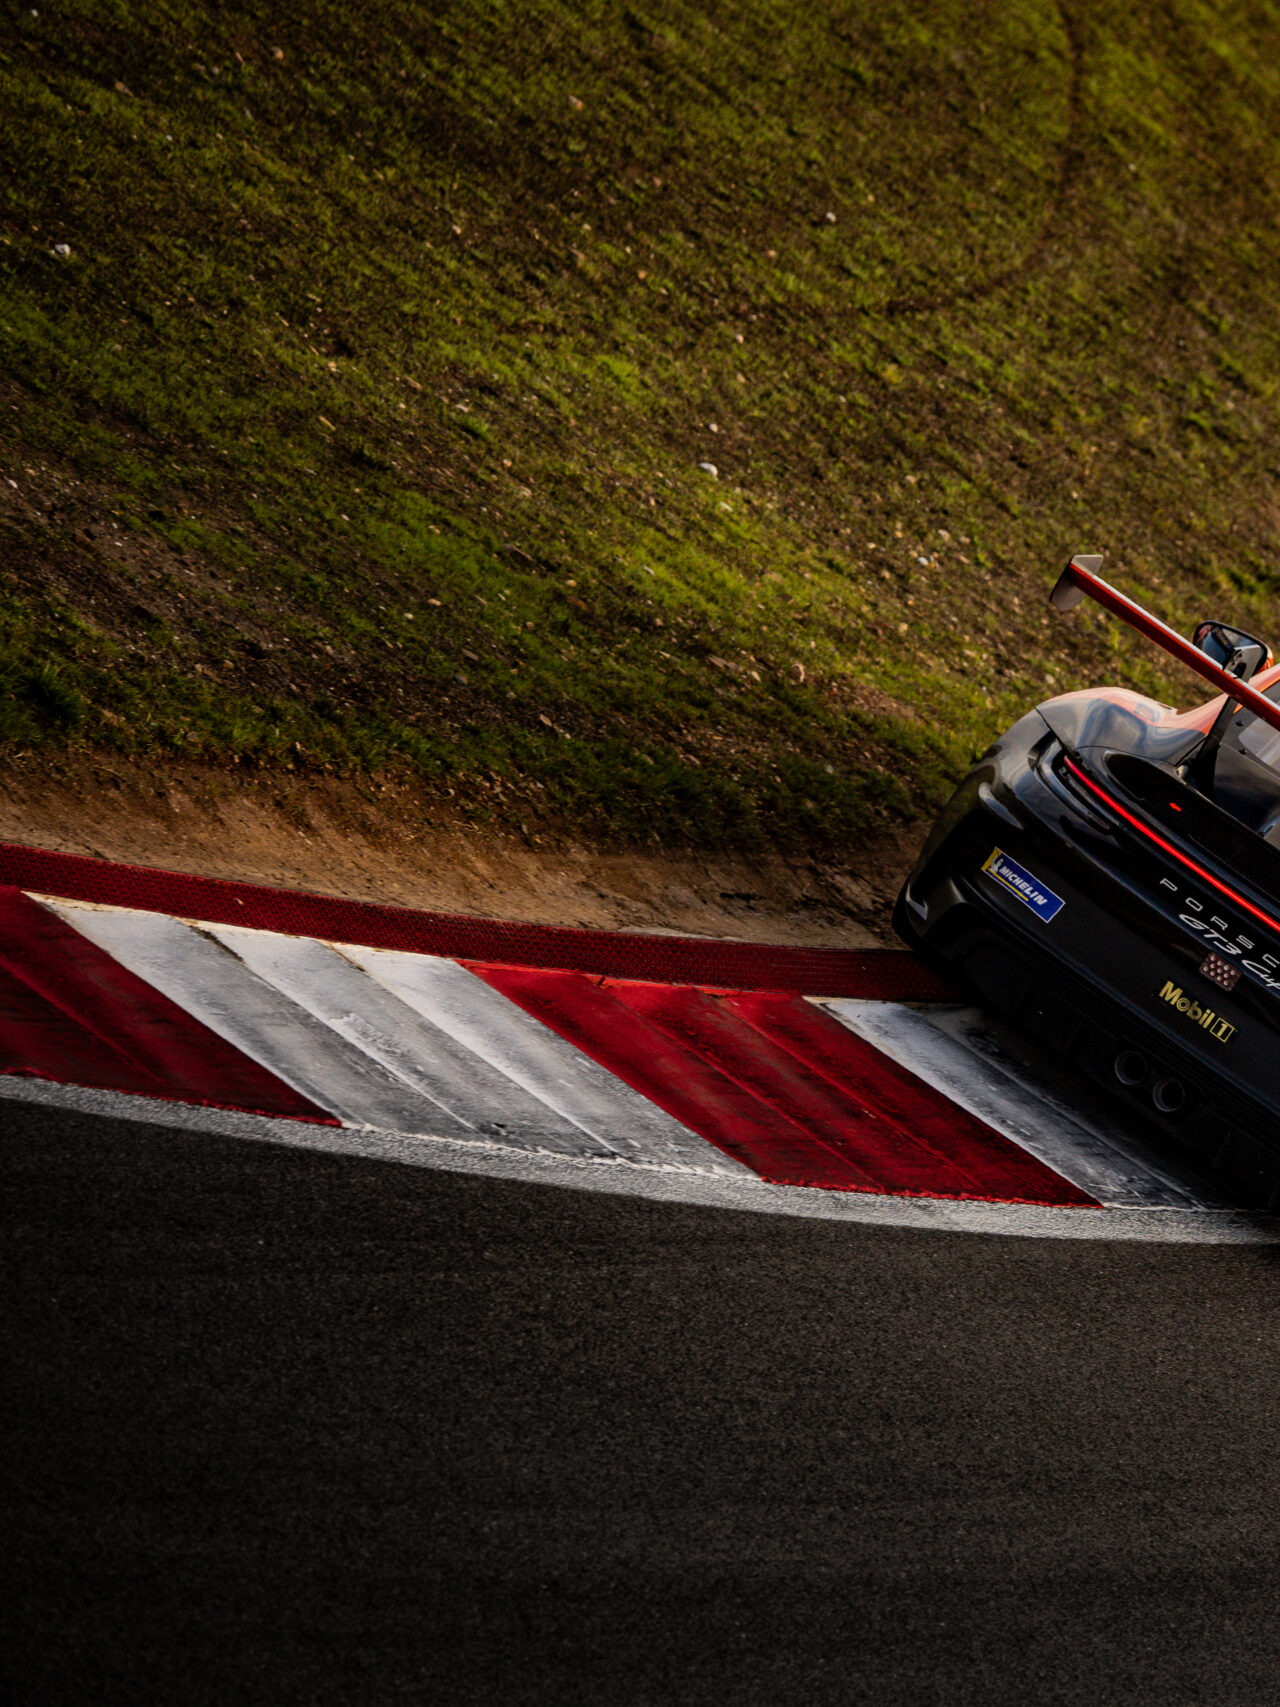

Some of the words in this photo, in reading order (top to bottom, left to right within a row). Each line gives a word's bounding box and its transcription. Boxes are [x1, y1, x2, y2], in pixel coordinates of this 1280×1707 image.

[999, 865, 1048, 906] MICHELIN
[1178, 913, 1243, 956] GT3
[1159, 980, 1216, 1029] Mobil
[1209, 1017, 1235, 1043] 1
